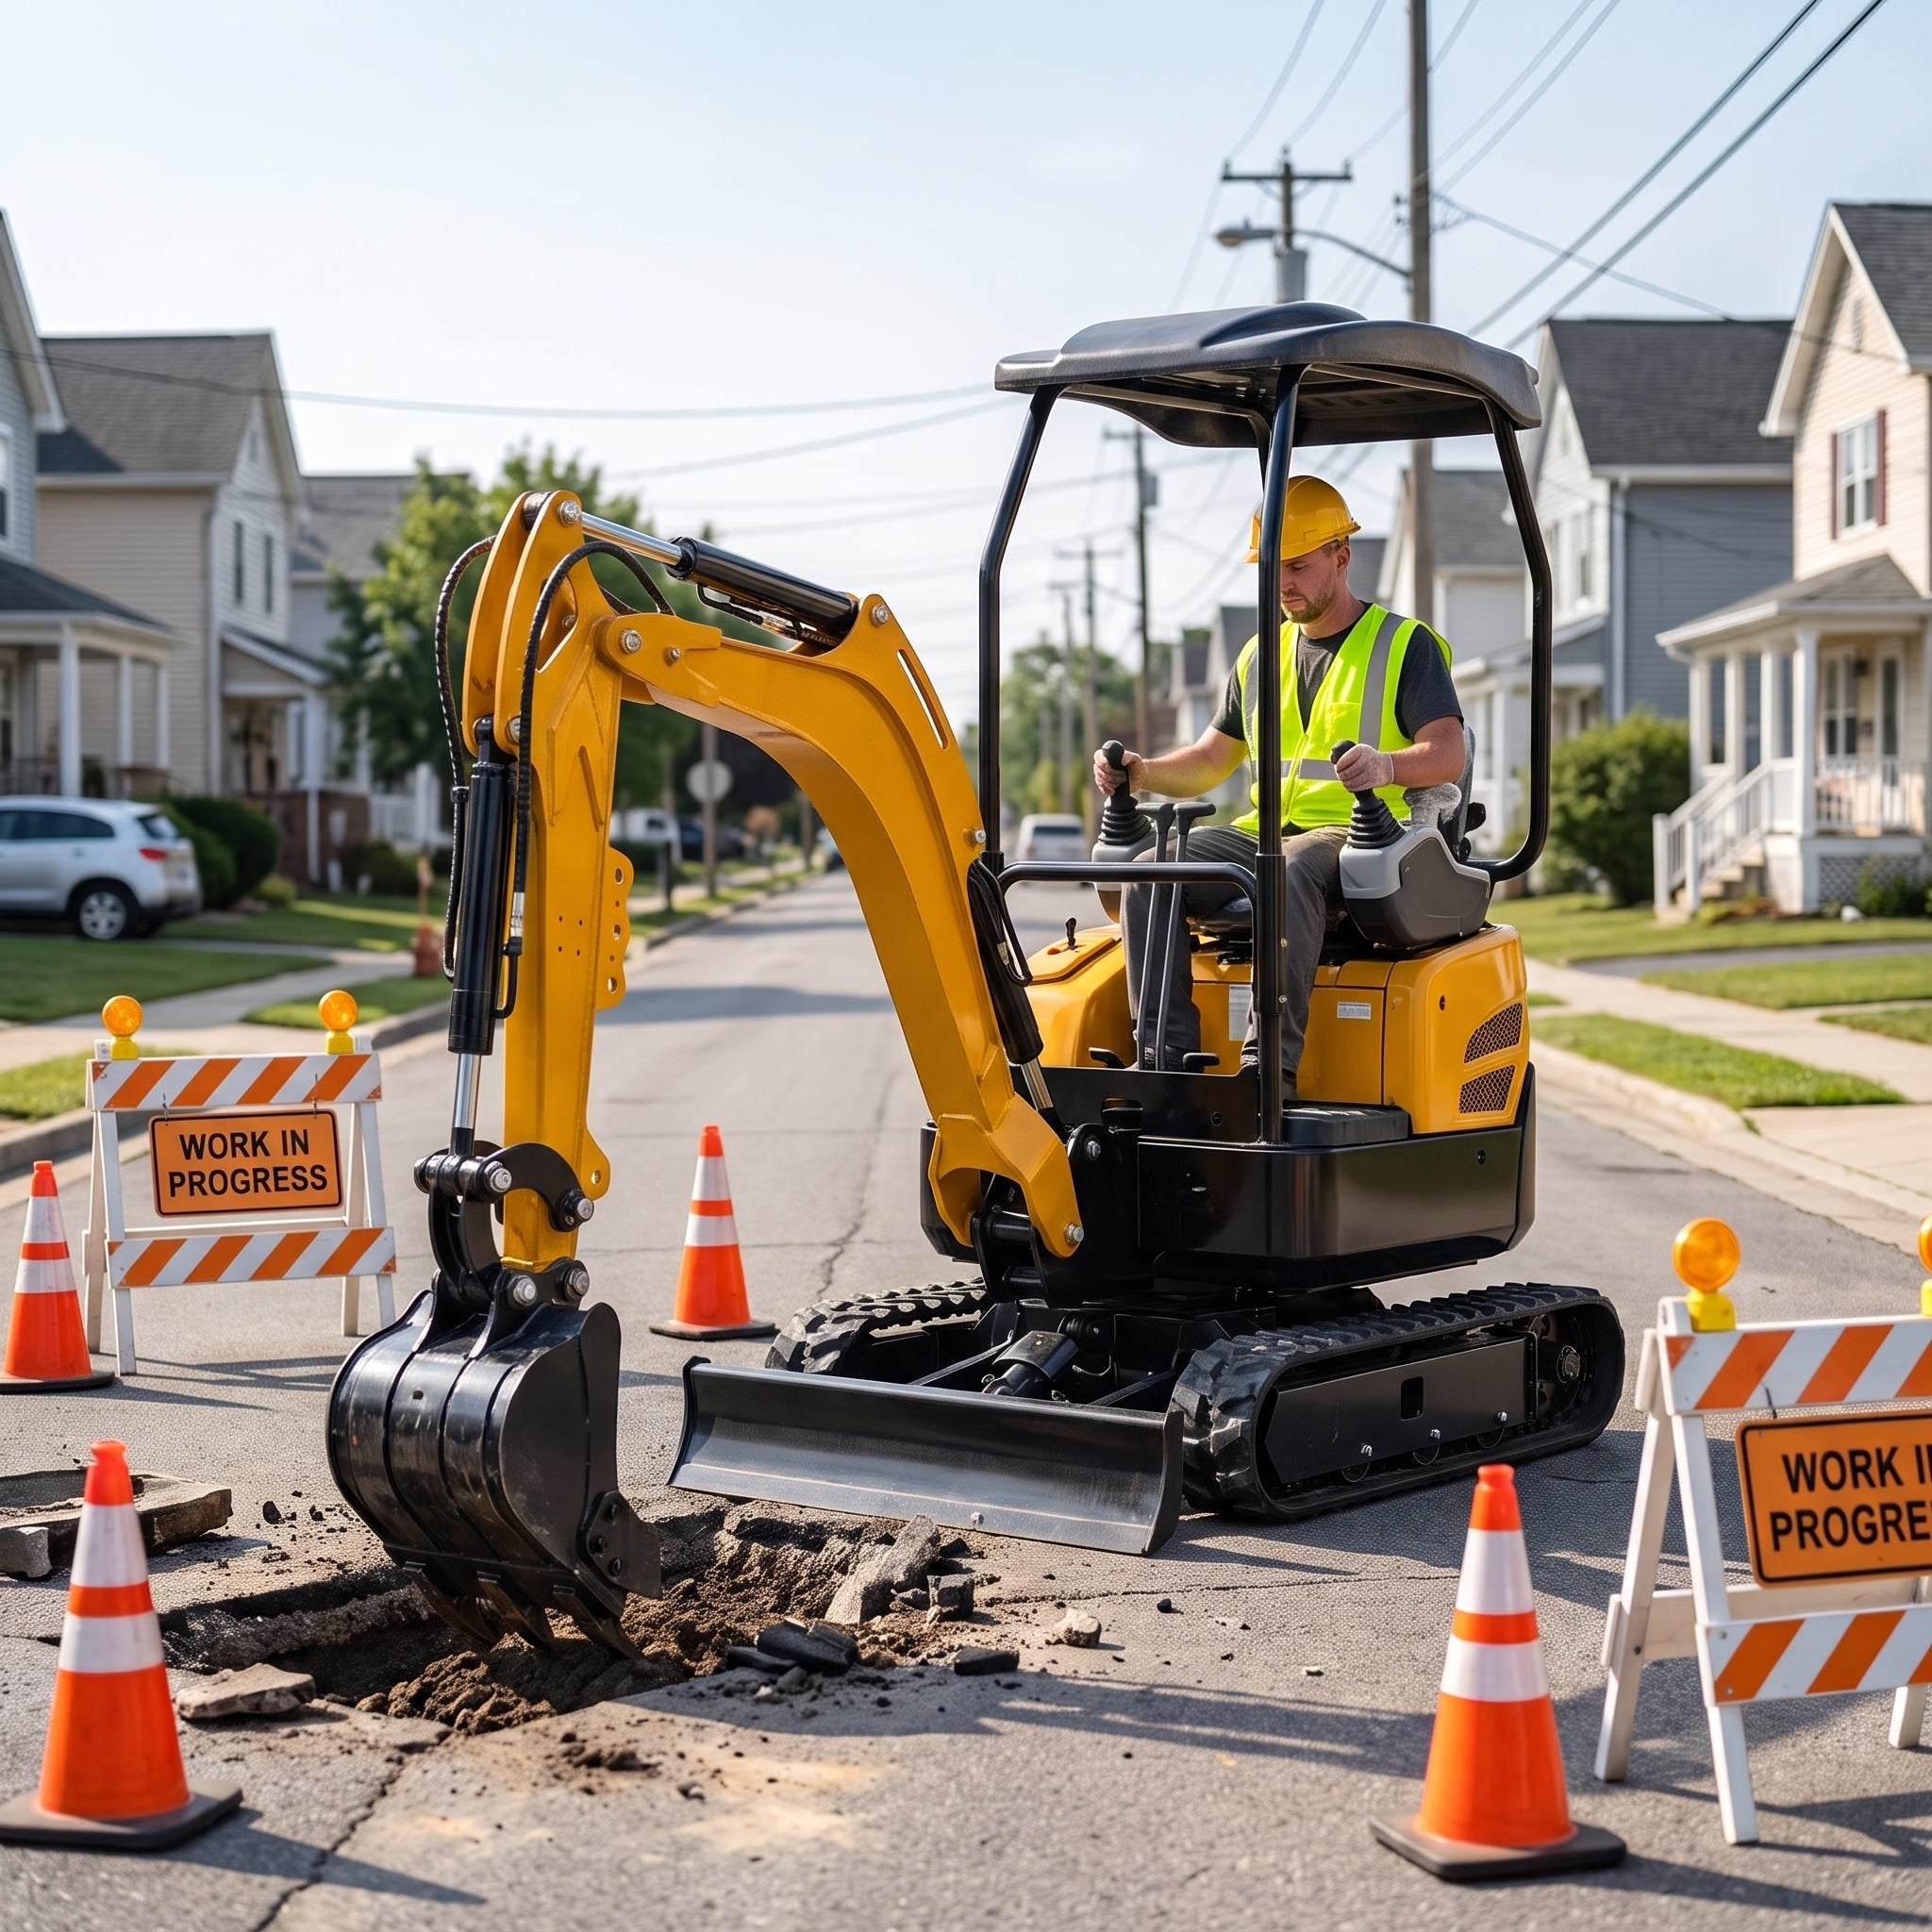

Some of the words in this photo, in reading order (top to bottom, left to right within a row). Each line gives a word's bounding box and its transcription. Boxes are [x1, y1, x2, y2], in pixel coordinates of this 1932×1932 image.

[178, 1130, 271, 1161] WORK
[280, 1128, 309, 1157] IN
[168, 1164, 327, 1198] PROGRESS
[1781, 1446, 1905, 1494] WORK
[1914, 1443, 1932, 1485] I
[1769, 1500, 1932, 1552] PROGRE
